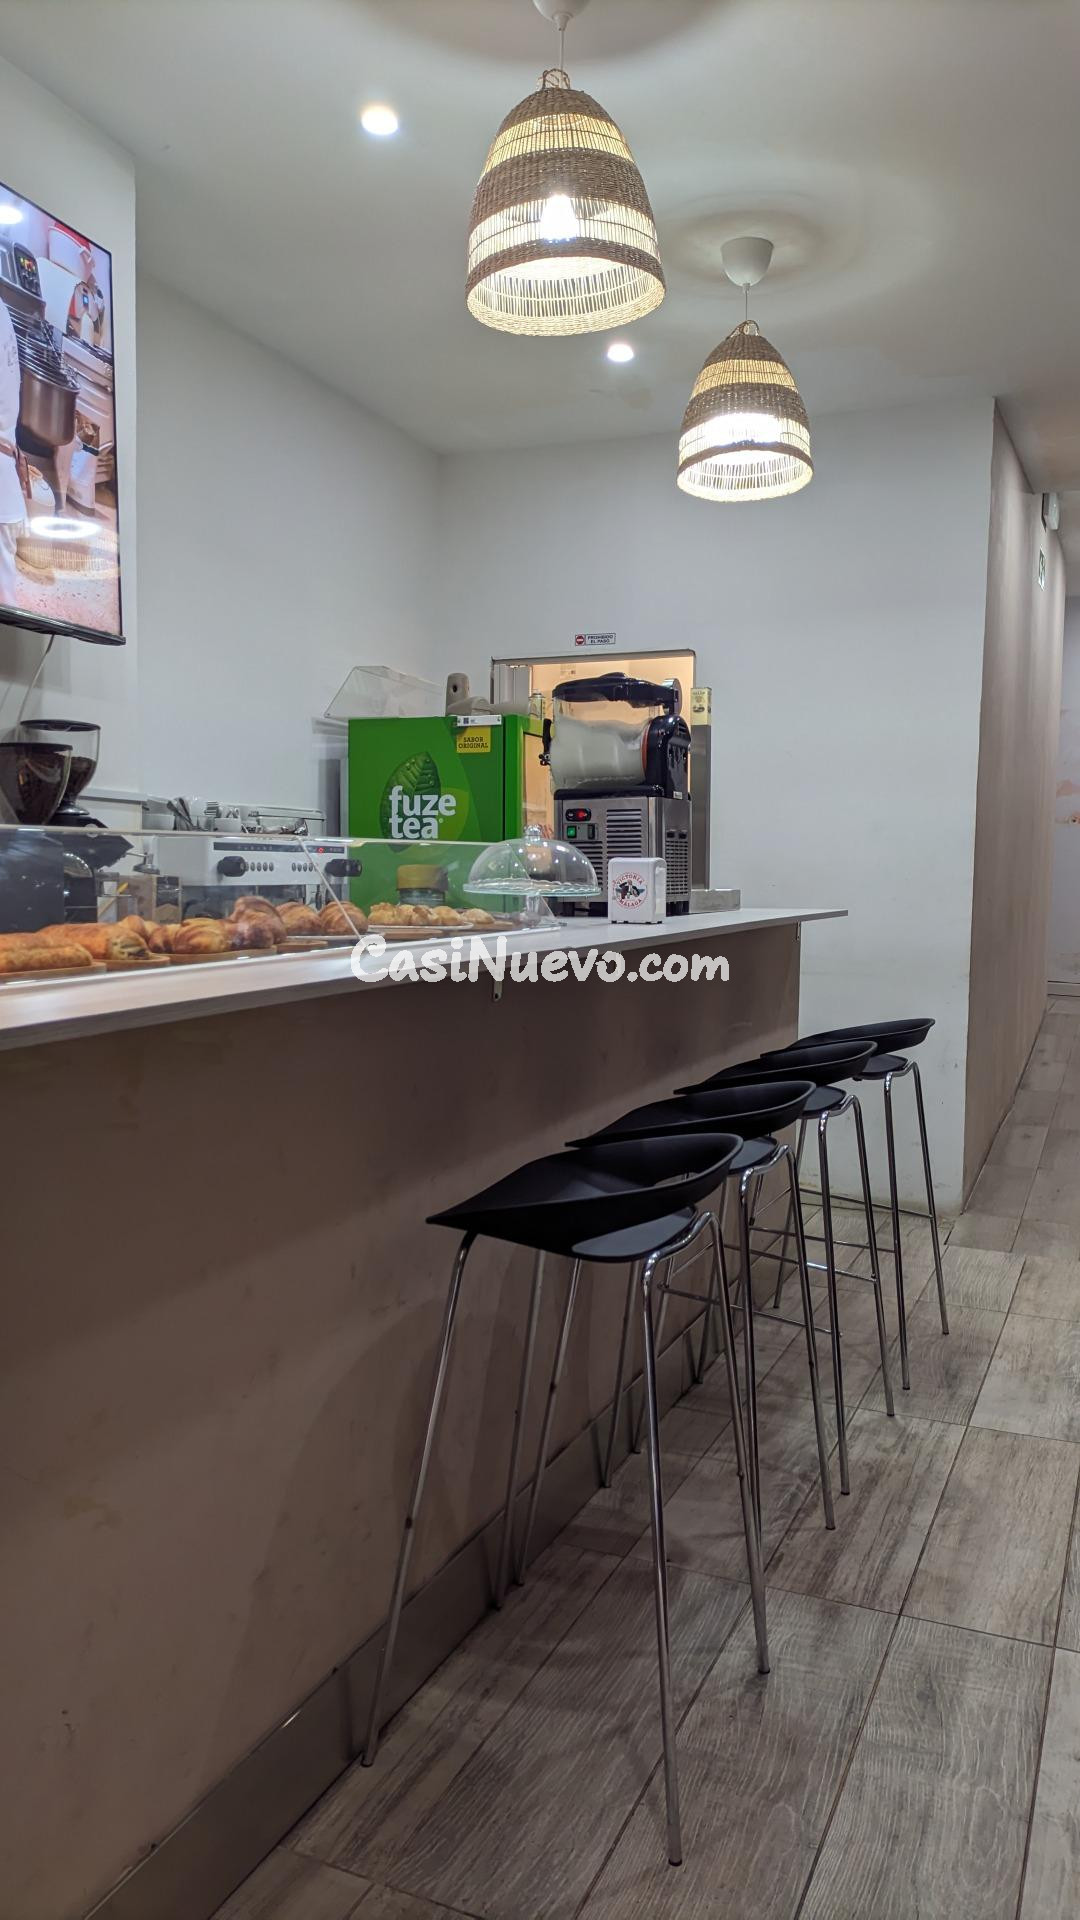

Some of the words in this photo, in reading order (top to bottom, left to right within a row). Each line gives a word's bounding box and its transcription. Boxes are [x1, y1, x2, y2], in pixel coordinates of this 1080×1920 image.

[389, 785, 457, 816] fuze
[389, 814, 439, 839] tea
[615, 874, 645, 886] VICTORIA
